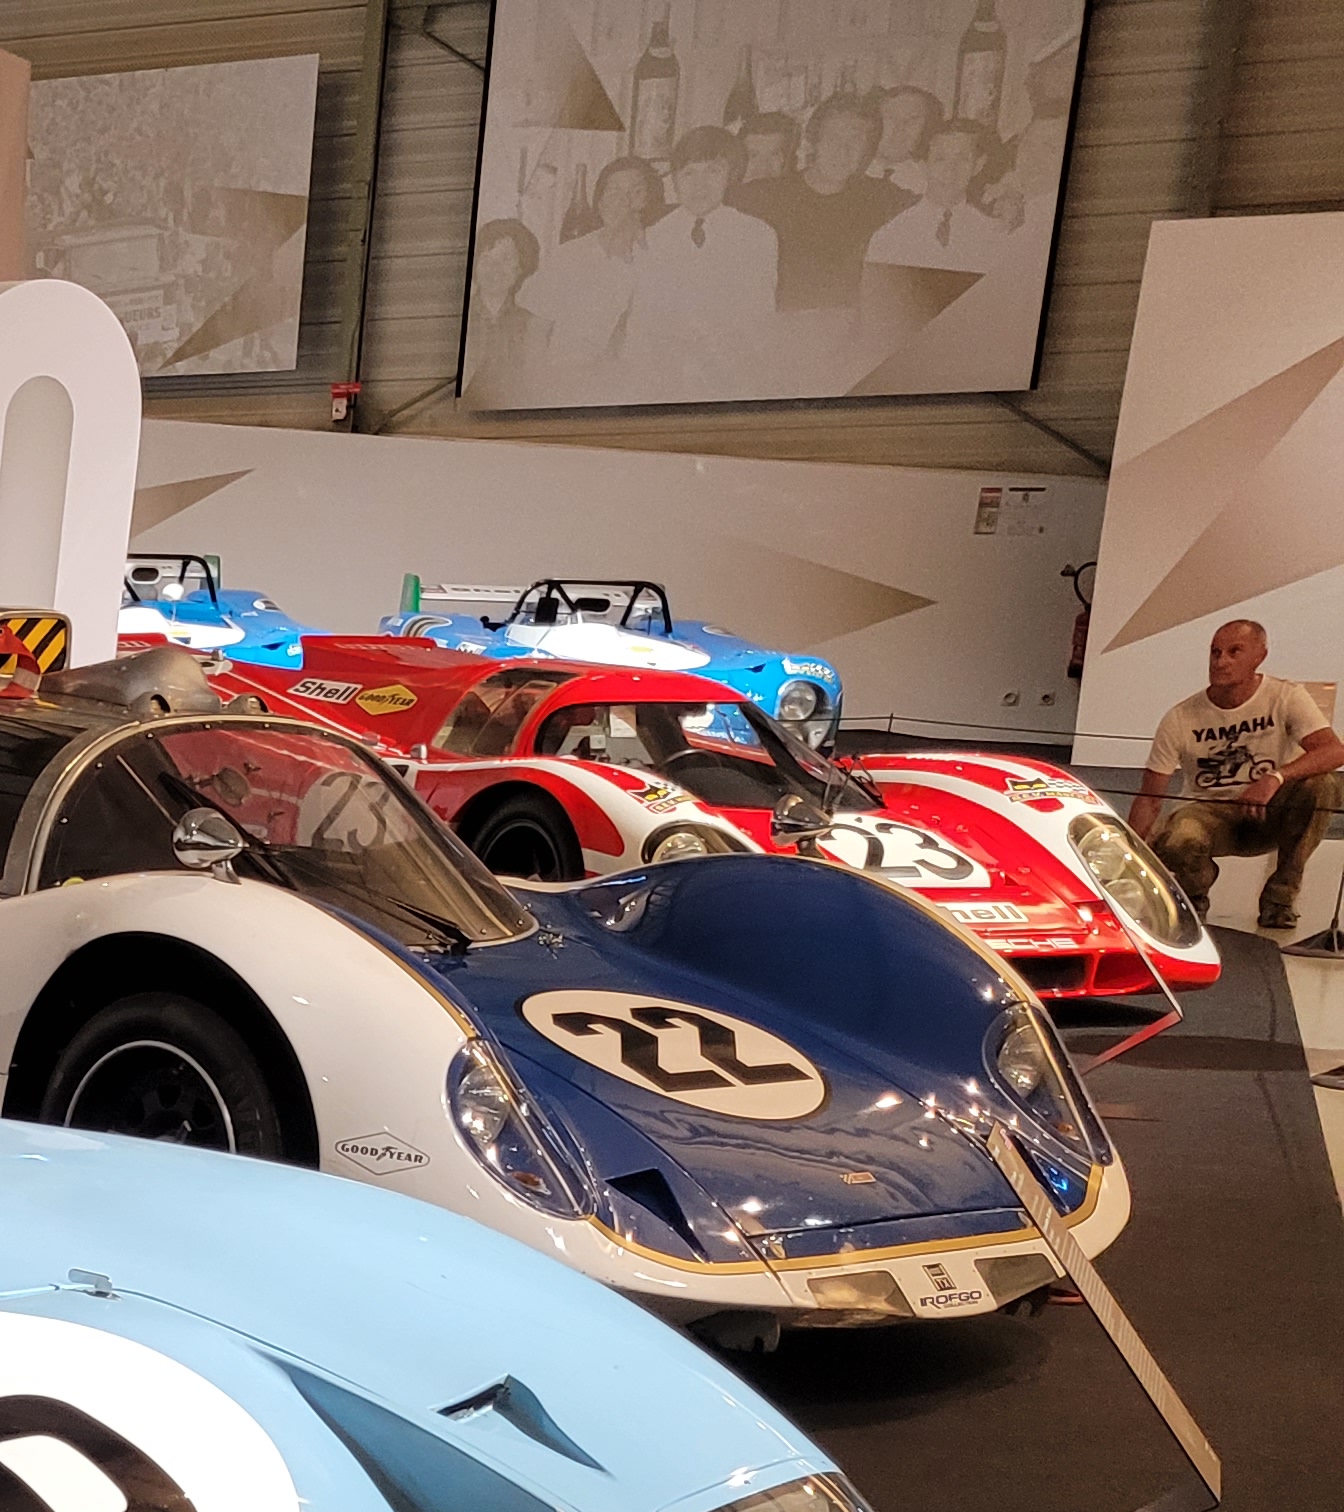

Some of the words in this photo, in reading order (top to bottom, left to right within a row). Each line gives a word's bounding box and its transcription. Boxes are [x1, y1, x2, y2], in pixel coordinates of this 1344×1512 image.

[293, 680, 359, 702] Shell
[1192, 716, 1275, 743] YAMAHA
[817, 822, 974, 881] 23
[551, 1006, 815, 1093] 22
